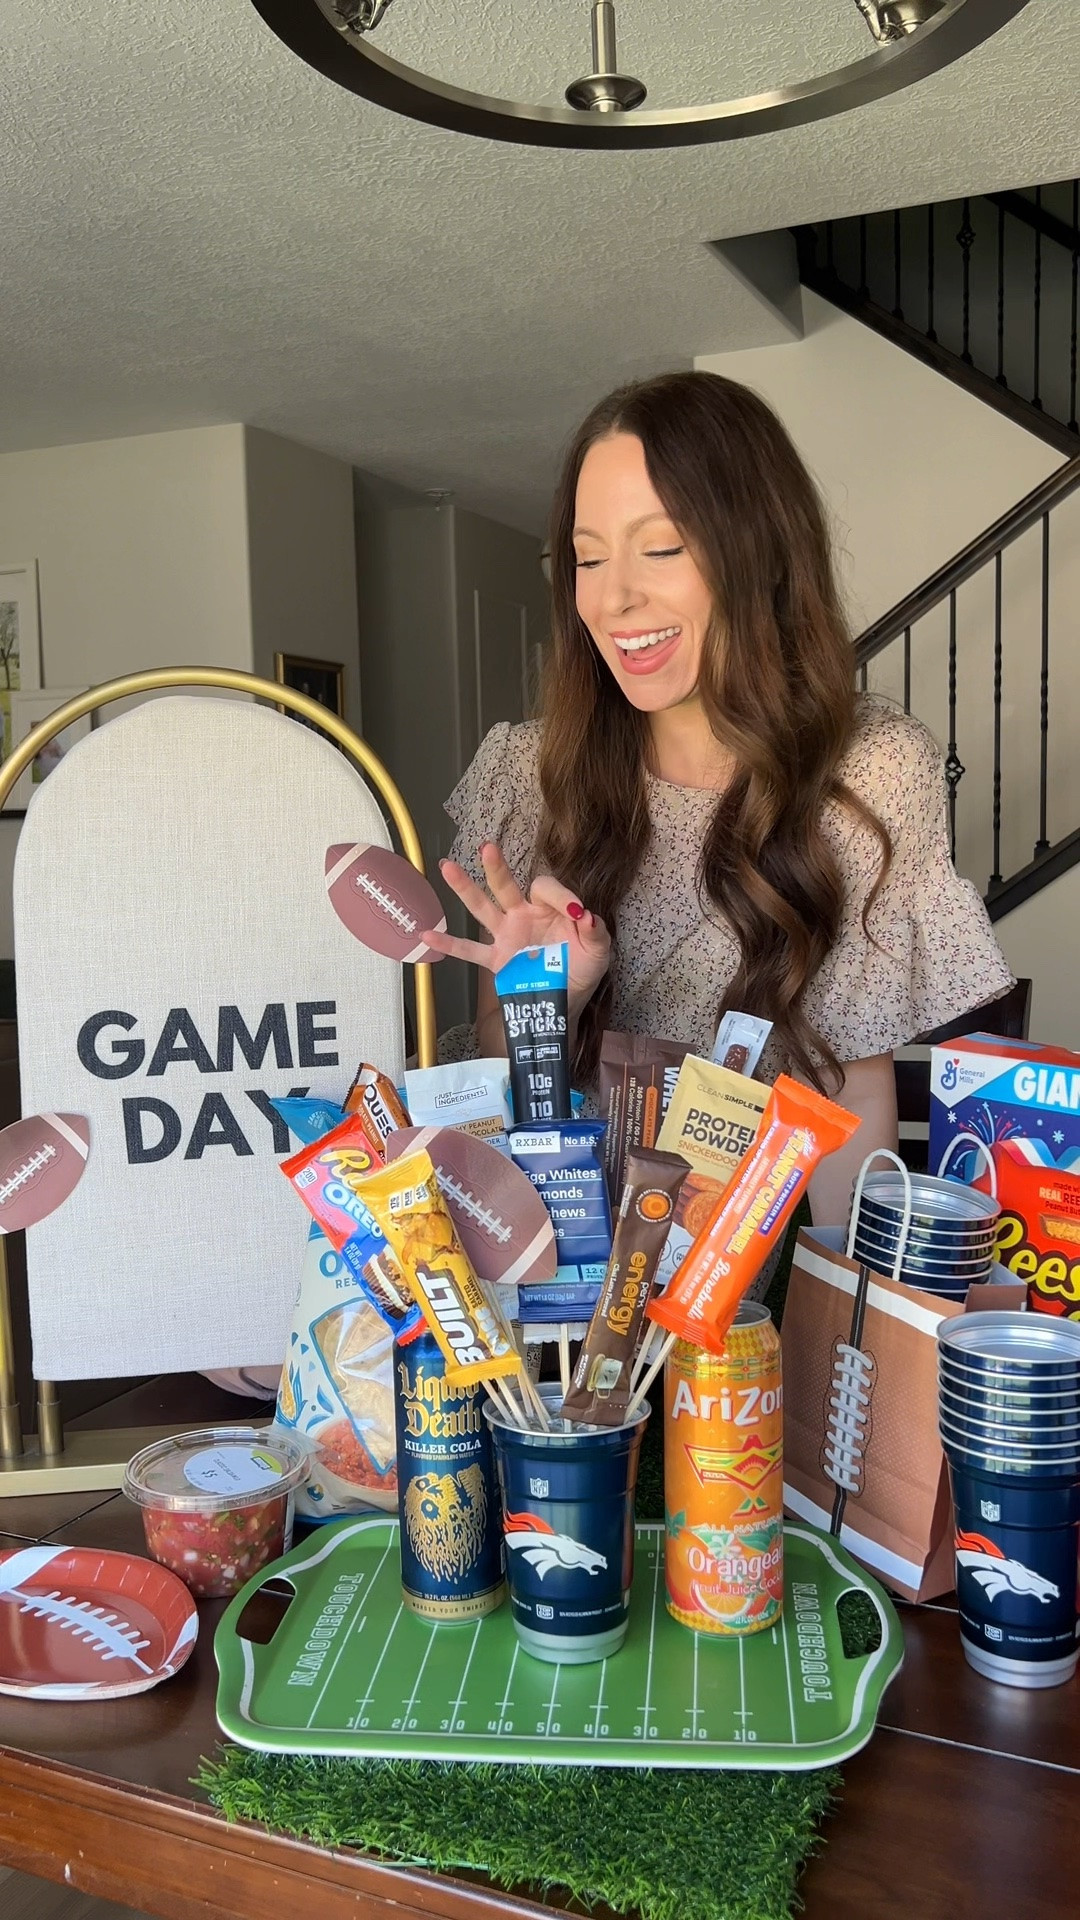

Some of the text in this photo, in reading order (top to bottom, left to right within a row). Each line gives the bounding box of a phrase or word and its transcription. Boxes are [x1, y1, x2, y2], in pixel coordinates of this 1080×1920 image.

[508, 1016, 566, 1038] STICKS
[76, 1001, 340, 1080] GAME
[528, 1074, 552, 1090] 10G
[960, 1068, 986, 1078] General
[960, 1076, 974, 1084] Mills
[438, 1090, 484, 1106] INGREDIENTS
[530, 1100, 552, 1118] 110
[628, 1088, 636, 1112] Calories
[364, 1084, 394, 1139] QUES
[122, 1087, 310, 1164] DAY
[366, 1122, 379, 1144] PEANUT
[469, 1119, 496, 1130] PEANUT
[686, 1108, 756, 1142] PROTEI
[516, 1138, 552, 1147] RXBAR
[564, 1136, 578, 1145] No
[682, 1123, 749, 1156] POWDE
[678, 1140, 738, 1168] SNICKERDOO
[766, 1128, 806, 1190] PEANUT
[302, 1168, 316, 1183] 200
[548, 1168, 597, 1180] Whites
[540, 1186, 584, 1200] monds
[762, 1170, 800, 1231] SOFT PROTEIN BAR
[1039, 1186, 1062, 1202] REAL
[323, 1181, 383, 1238] OREO
[548, 1207, 586, 1218] hews
[1045, 1200, 1068, 1212] Peanut
[725, 1186, 776, 1256] CARAMEL
[463, 1284, 479, 1309] SALTED
[467, 1276, 483, 1306] CARAMEL
[607, 1251, 646, 1336] energy
[637, 1282, 650, 1308] perk
[687, 1257, 730, 1320] Barebells
[416, 1272, 486, 1366] BUILT
[404, 1399, 481, 1438] Death
[404, 1439, 482, 1454] KILLER COLA
[700, 1522, 726, 1533] ALL
[692, 1580, 720, 1594] Fruit
[725, 1584, 756, 1595] Juice
[287, 1572, 364, 1687] TOUCHDOWN
[792, 1582, 832, 1703] TOUCHDOWN
